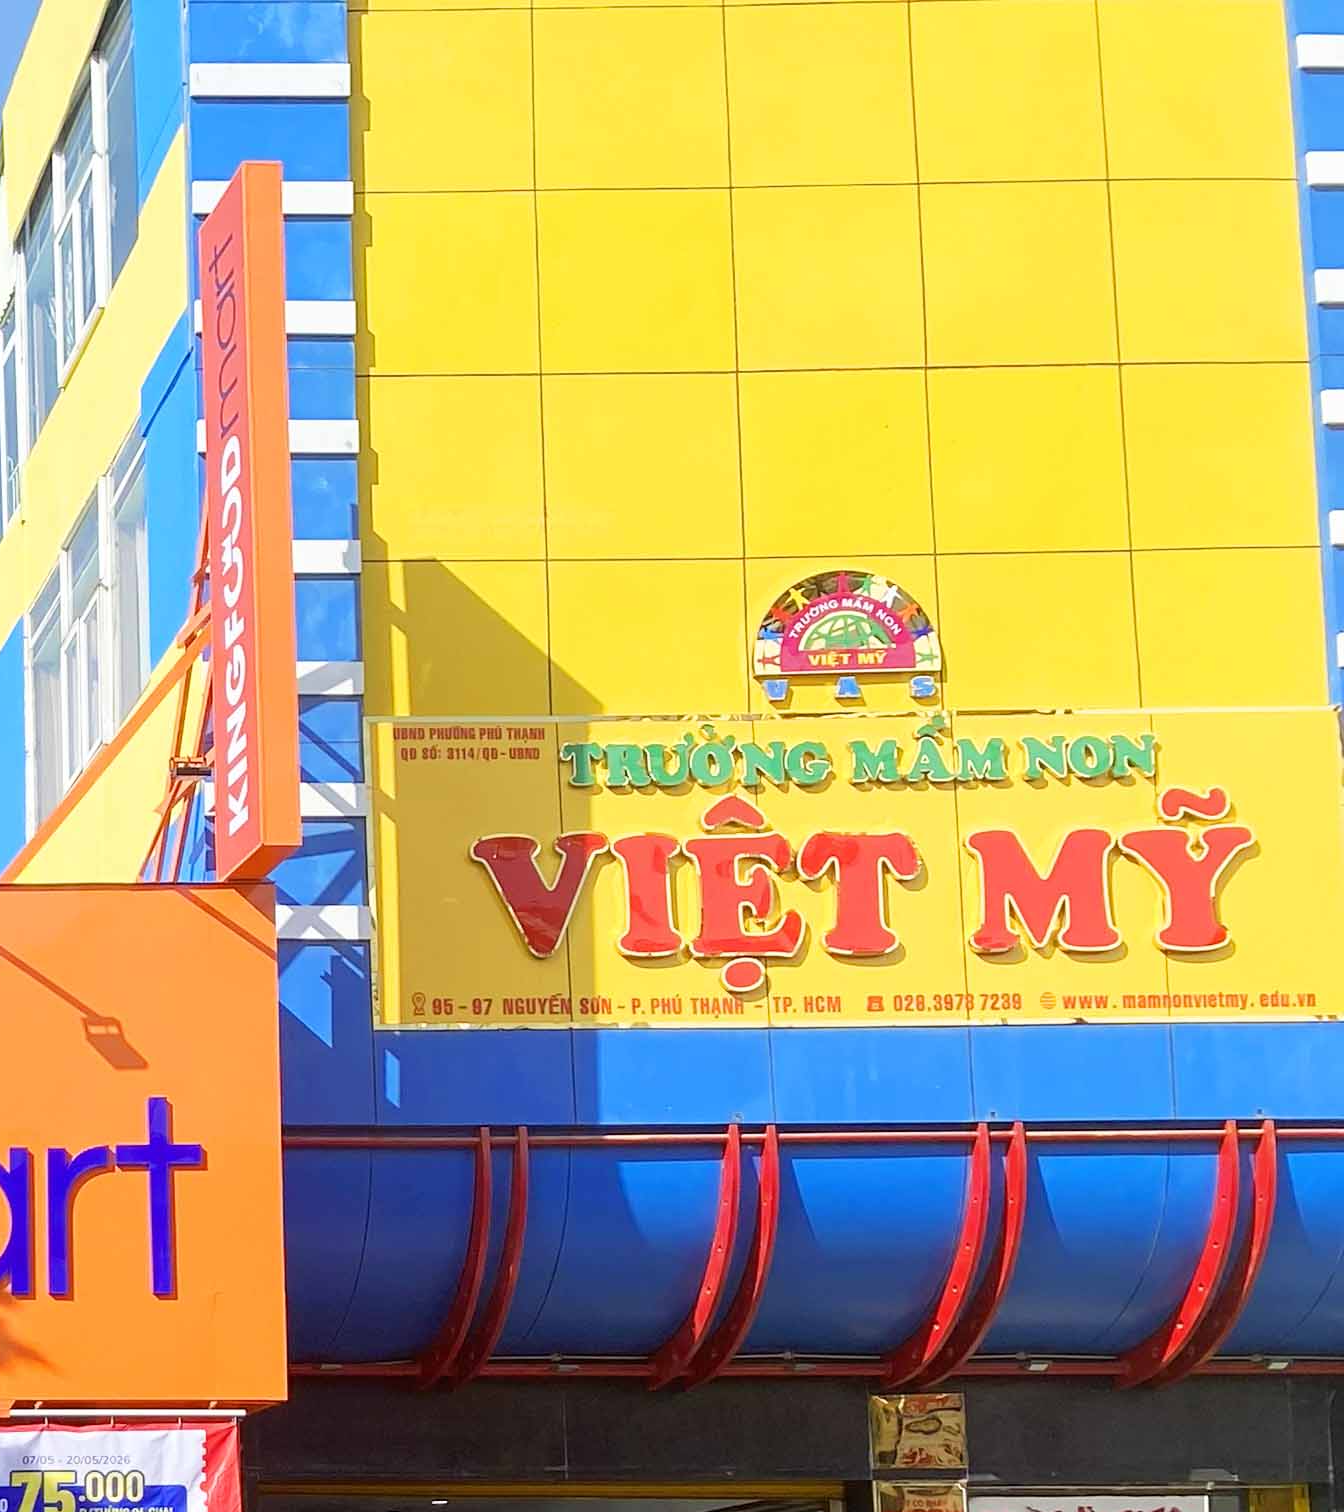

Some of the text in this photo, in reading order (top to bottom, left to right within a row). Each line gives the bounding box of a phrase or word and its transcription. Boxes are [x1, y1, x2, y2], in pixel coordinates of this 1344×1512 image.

[875, 607, 903, 636] NON
[808, 650, 888, 668] VIỆT MỸ
[393, 727, 425, 741] UBND
[479, 725, 503, 740] PHÚ
[506, 727, 545, 743] THẠNH
[560, 722, 833, 788] TRƯỜNG
[1021, 732, 1158, 782] NON
[469, 786, 1258, 993] VIỆT MỸ
[431, 998, 454, 1016] 95
[471, 998, 493, 1016] 97
[650, 993, 683, 1015] PHÚ
[689, 997, 745, 1019] THẠNH
[803, 995, 842, 1013] HCM
[21, 1455, 55, 1466] 07/05
[65, 1454, 131, 1466] 20/05/2026
